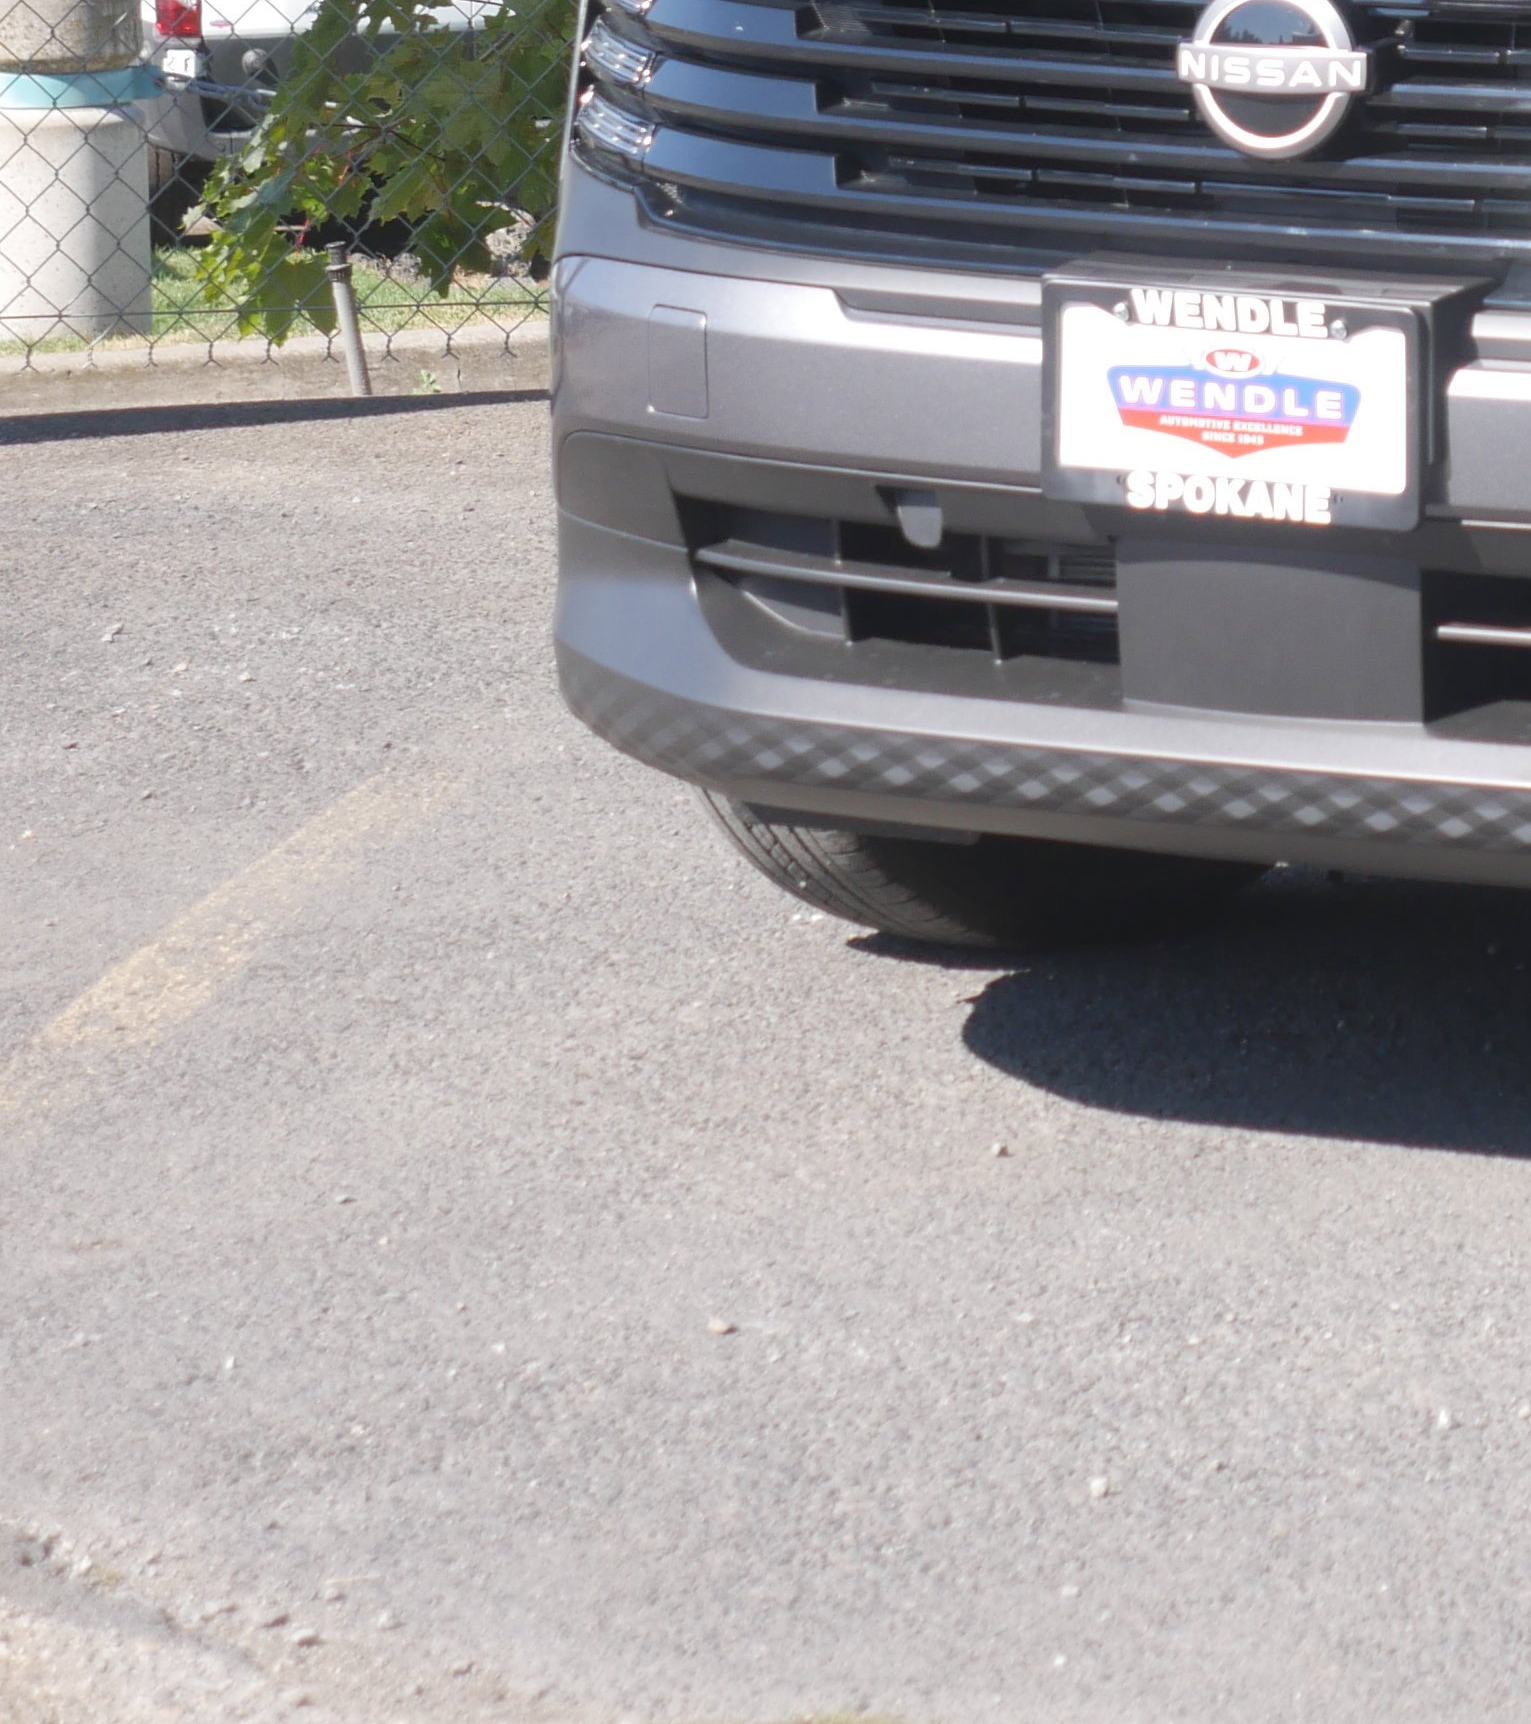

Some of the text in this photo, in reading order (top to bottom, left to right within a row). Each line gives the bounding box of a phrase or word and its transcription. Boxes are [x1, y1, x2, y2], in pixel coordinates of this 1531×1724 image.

[1180, 49, 1364, 88] NISSAN
[1130, 288, 1329, 339] WENDLE
[1119, 375, 1342, 420] WENDLE
[1159, 414, 1304, 437] AUTOMOTIVE EXCELLENCE
[1202, 431, 1236, 444] SINCE
[1126, 471, 1332, 525] SPOKANE
